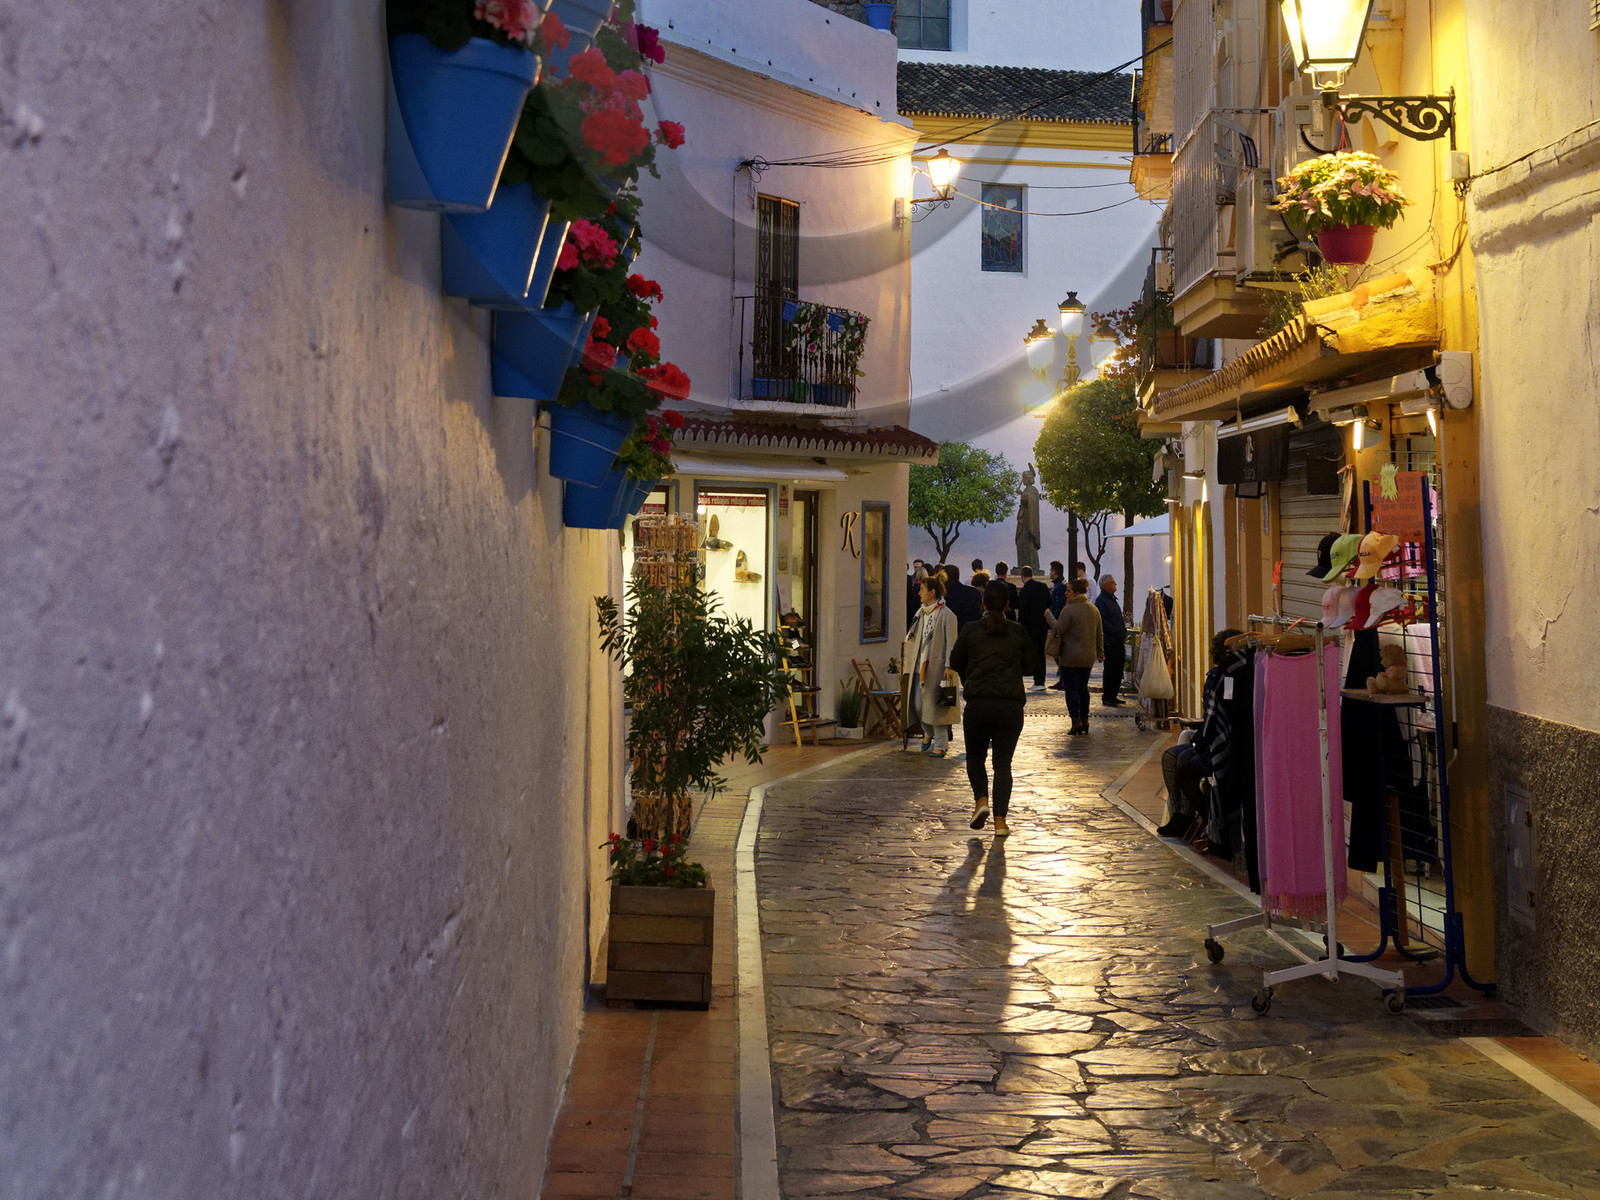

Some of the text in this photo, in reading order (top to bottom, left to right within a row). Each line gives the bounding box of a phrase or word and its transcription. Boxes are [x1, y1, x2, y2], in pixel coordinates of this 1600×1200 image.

[711, 496, 730, 506] rebajas
[730, 496, 748, 507] rebajas
[840, 511, 862, 559] K
